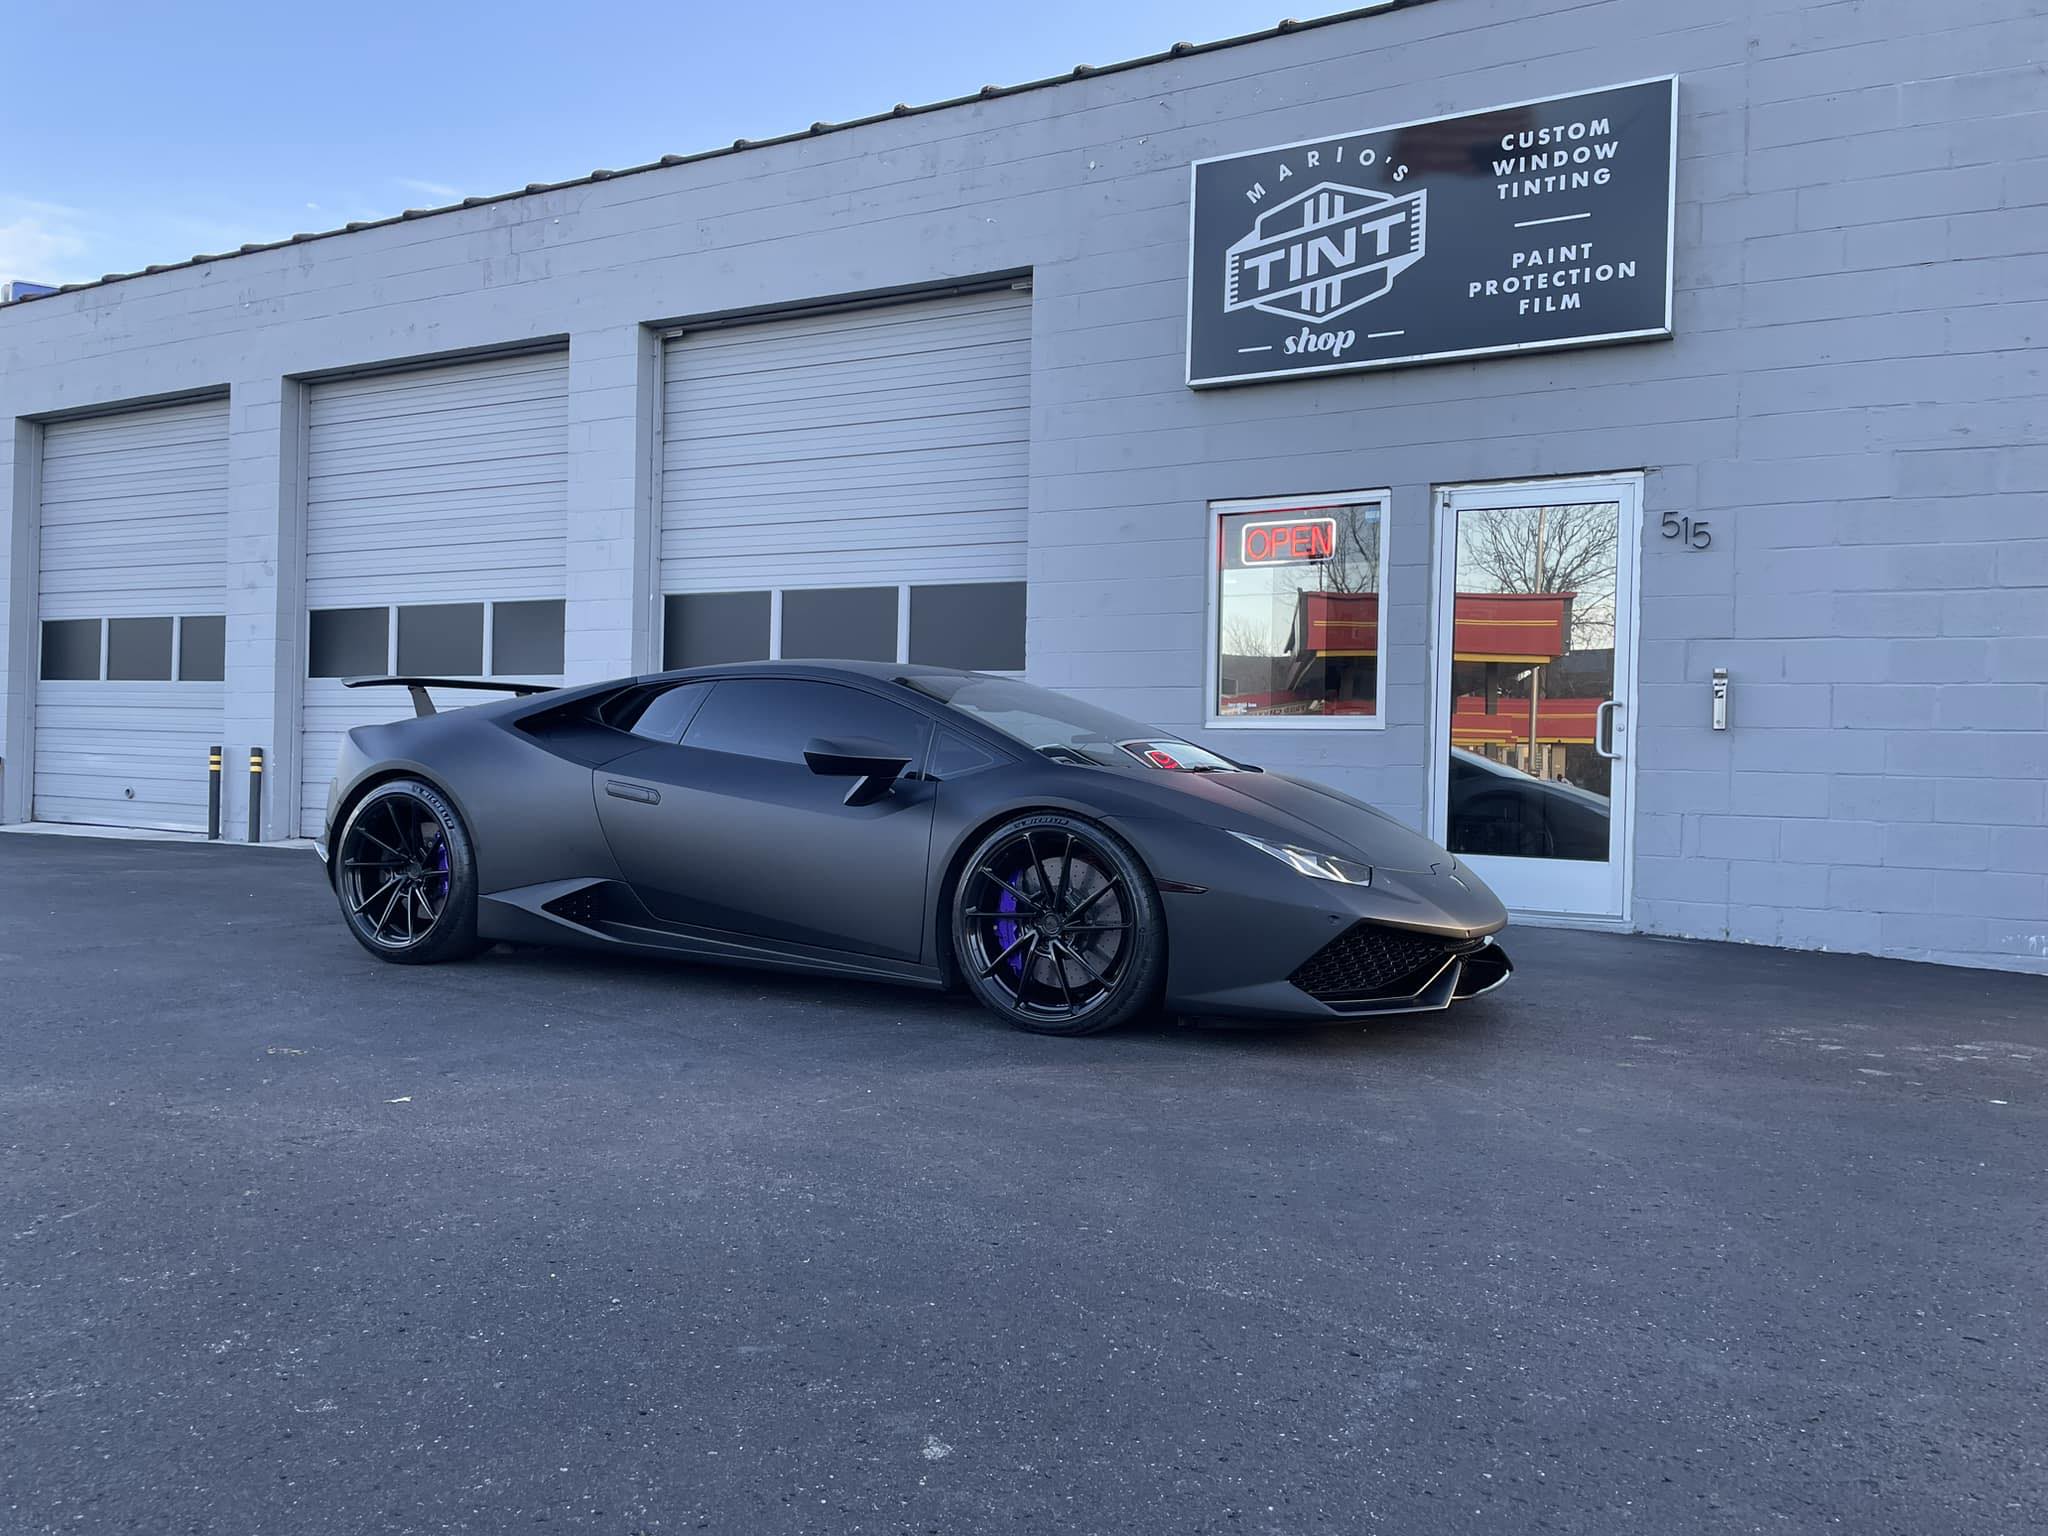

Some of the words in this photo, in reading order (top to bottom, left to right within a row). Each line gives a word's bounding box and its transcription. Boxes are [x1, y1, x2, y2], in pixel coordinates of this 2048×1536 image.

[1501, 118, 1611, 152] CUSTOM
[1245, 146, 1409, 205] MARIO'S
[1493, 141, 1619, 177] WINDOW
[1497, 168, 1612, 200] TINTING
[1243, 211, 1407, 290] TINT
[1512, 242, 1593, 268] PAINT
[1468, 261, 1637, 298] PROTECTION
[1519, 293, 1581, 315] FILM
[1284, 326, 1355, 357] shop
[1247, 524, 1332, 560] OPEN
[1662, 511, 1711, 549] 515
